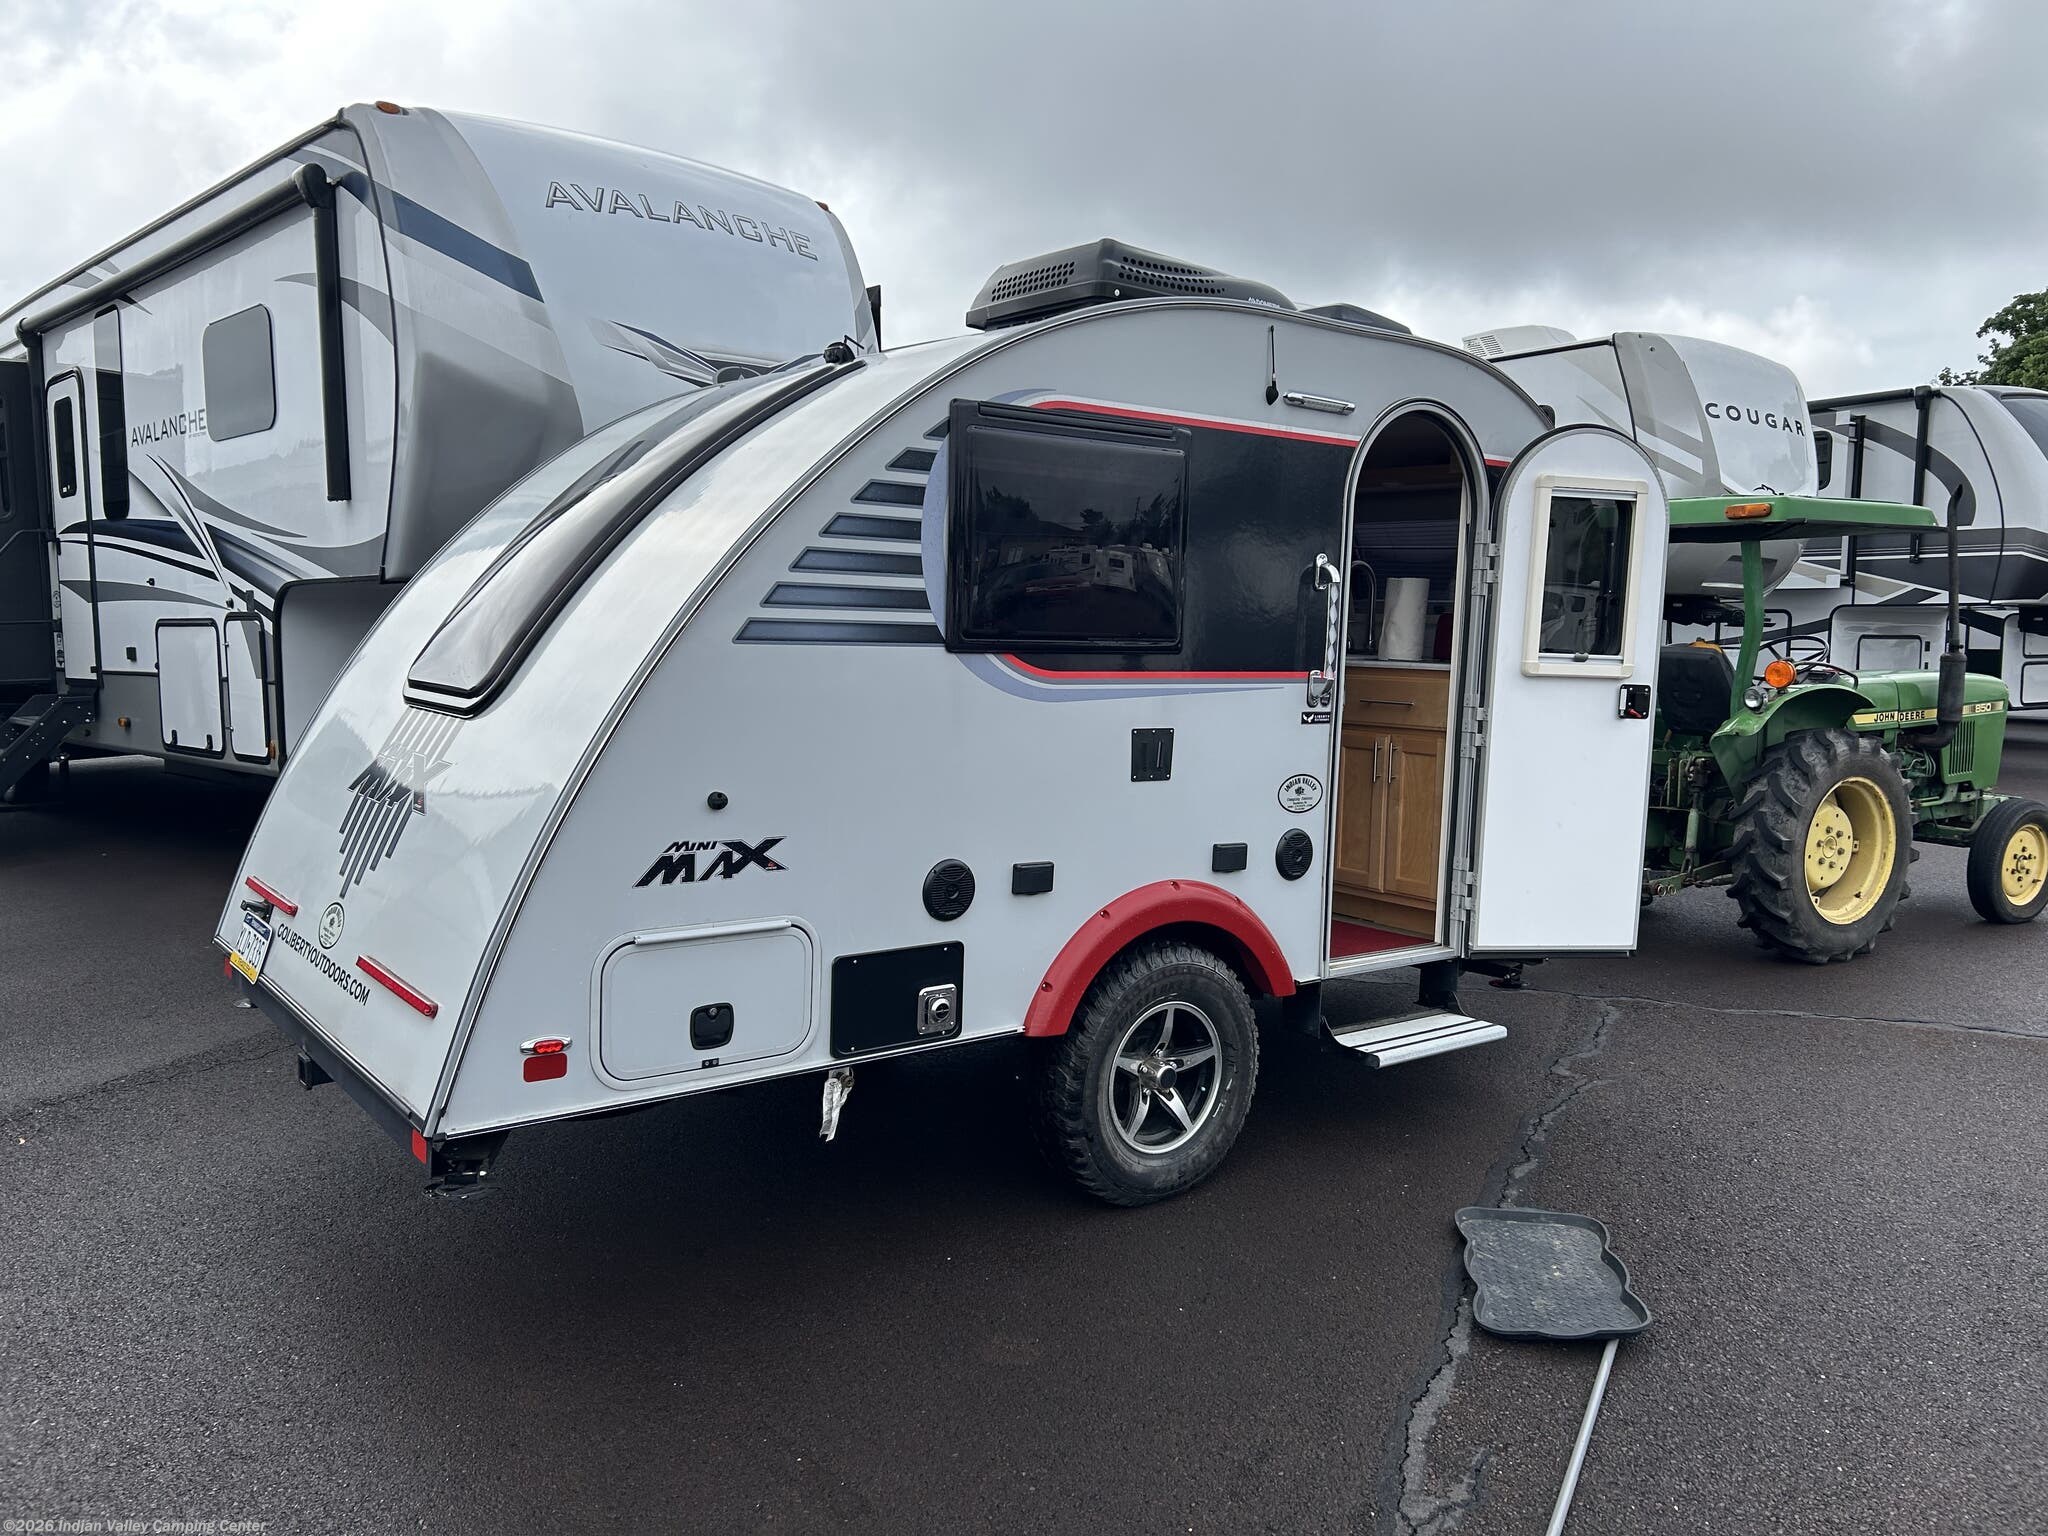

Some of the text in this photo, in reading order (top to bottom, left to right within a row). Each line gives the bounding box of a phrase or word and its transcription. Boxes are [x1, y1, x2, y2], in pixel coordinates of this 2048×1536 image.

[545, 181, 818, 261] AVALANCHE
[131, 408, 206, 448] AVALANCHE
[1704, 402, 1805, 436] COUGAR
[1873, 710, 1926, 723] JOHN DEERE
[1975, 702, 1992, 713] 850
[632, 835, 788, 888] MAX
[662, 840, 718, 854] MINI
